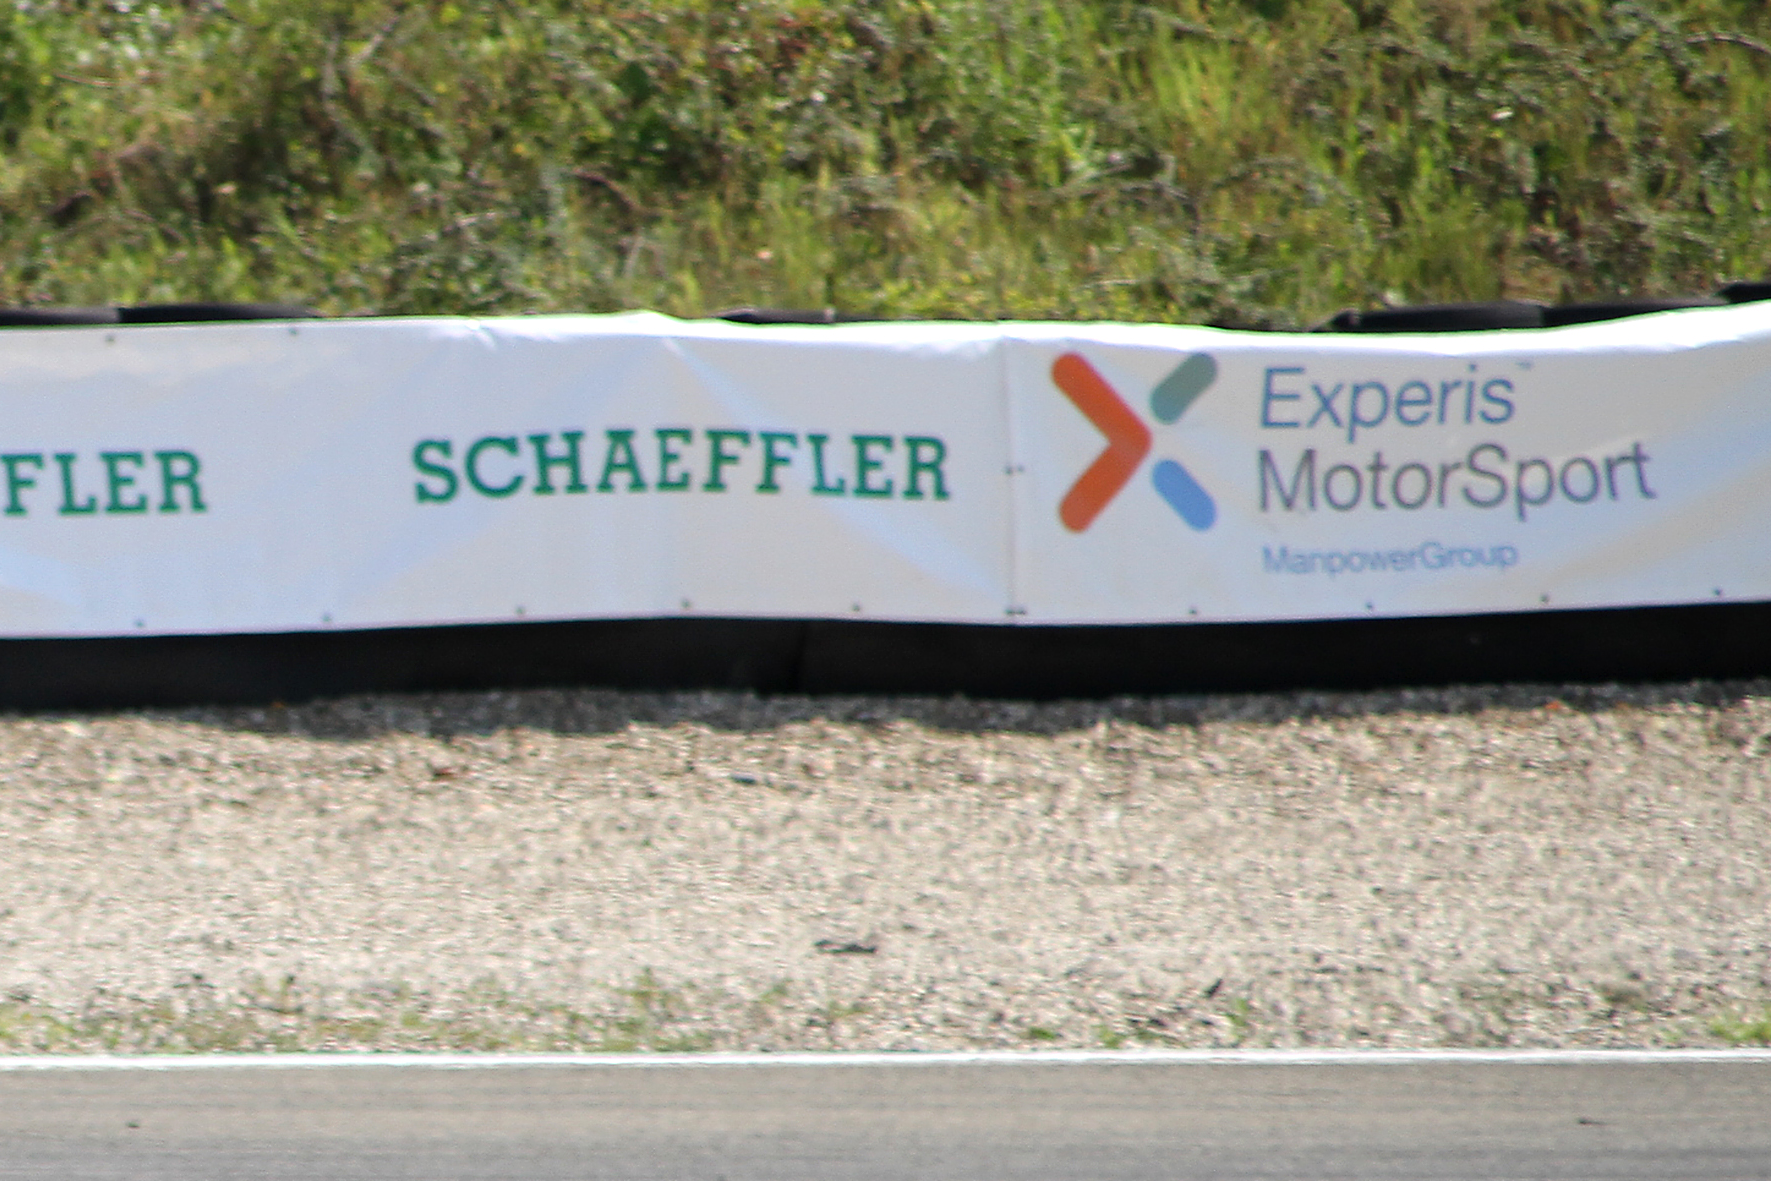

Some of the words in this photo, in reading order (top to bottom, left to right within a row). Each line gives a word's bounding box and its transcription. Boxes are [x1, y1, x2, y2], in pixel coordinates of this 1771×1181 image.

[1259, 363, 1516, 444] Experis
[411, 428, 951, 504] SCHAEFFLER
[1257, 441, 1658, 523] MotorSport
[1262, 541, 1519, 579] ManpowerGroup
